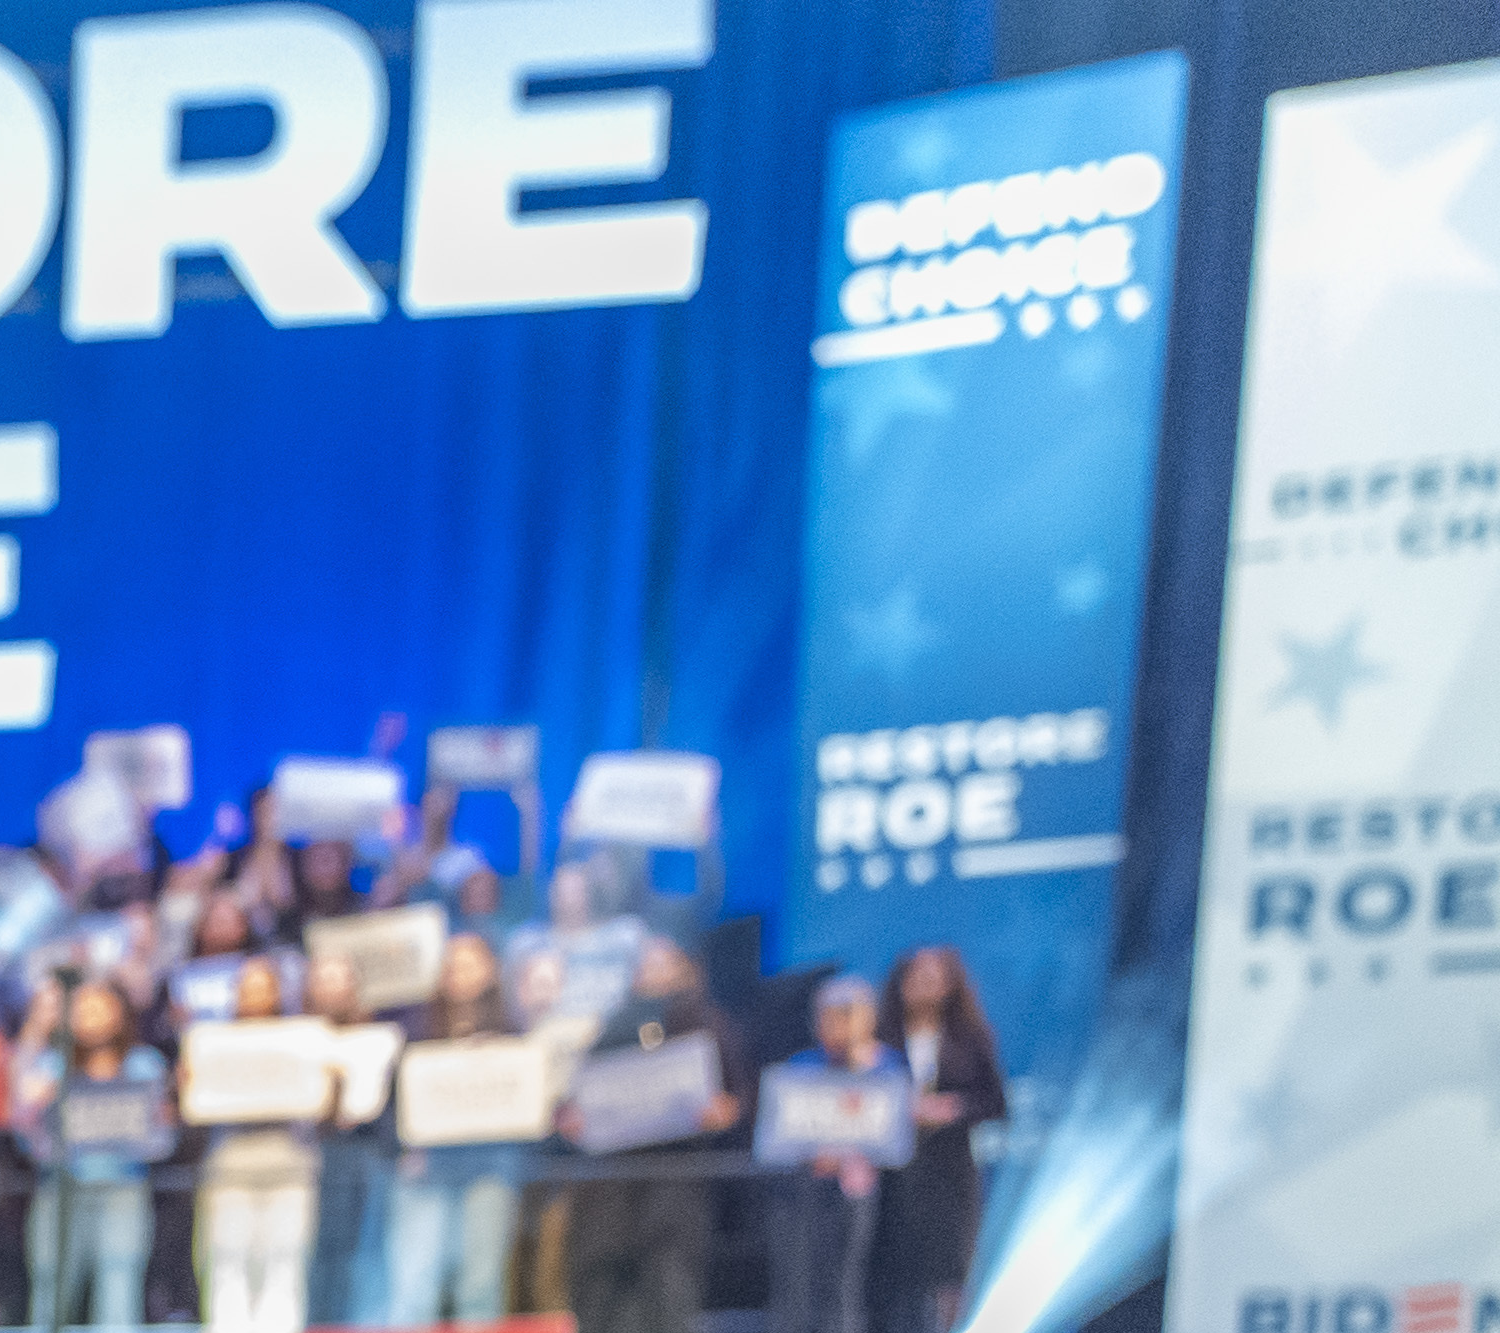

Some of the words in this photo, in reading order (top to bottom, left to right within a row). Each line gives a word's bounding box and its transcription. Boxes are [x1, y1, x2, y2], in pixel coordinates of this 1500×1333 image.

[816, 708, 1108, 784] RESTORE
[815, 766, 1022, 856] ROE
[1245, 861, 1500, 942] ROE
